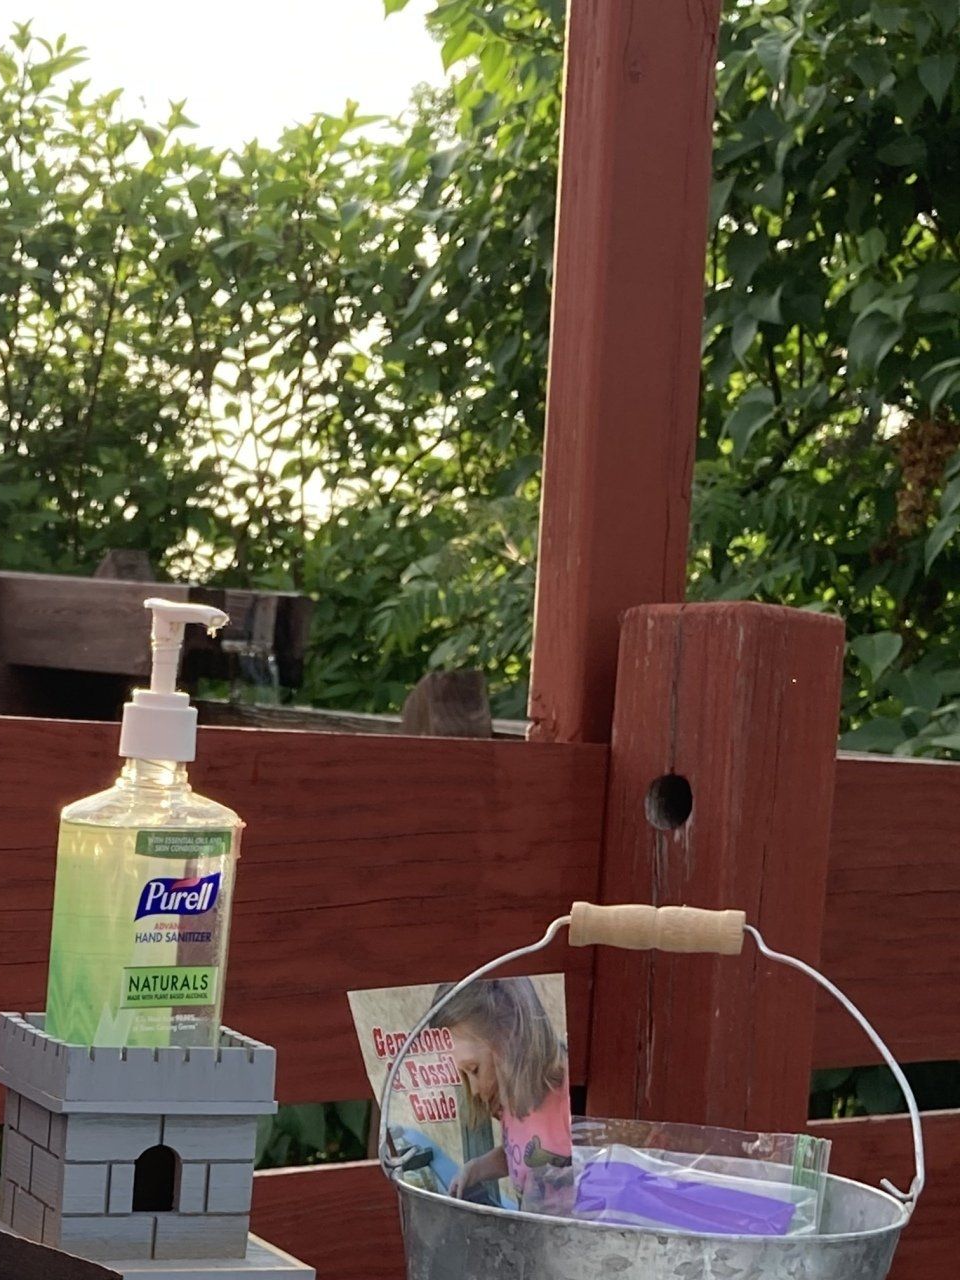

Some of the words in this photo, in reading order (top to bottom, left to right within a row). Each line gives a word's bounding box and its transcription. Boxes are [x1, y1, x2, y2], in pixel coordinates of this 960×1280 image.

[144, 881, 214, 911] Purell
[135, 932, 162, 943] HAND
[165, 931, 211, 943] SANITIZER
[129, 974, 208, 992] NATURALS
[406, 1057, 461, 1088] Fossil
[409, 1091, 457, 1122] Guide
